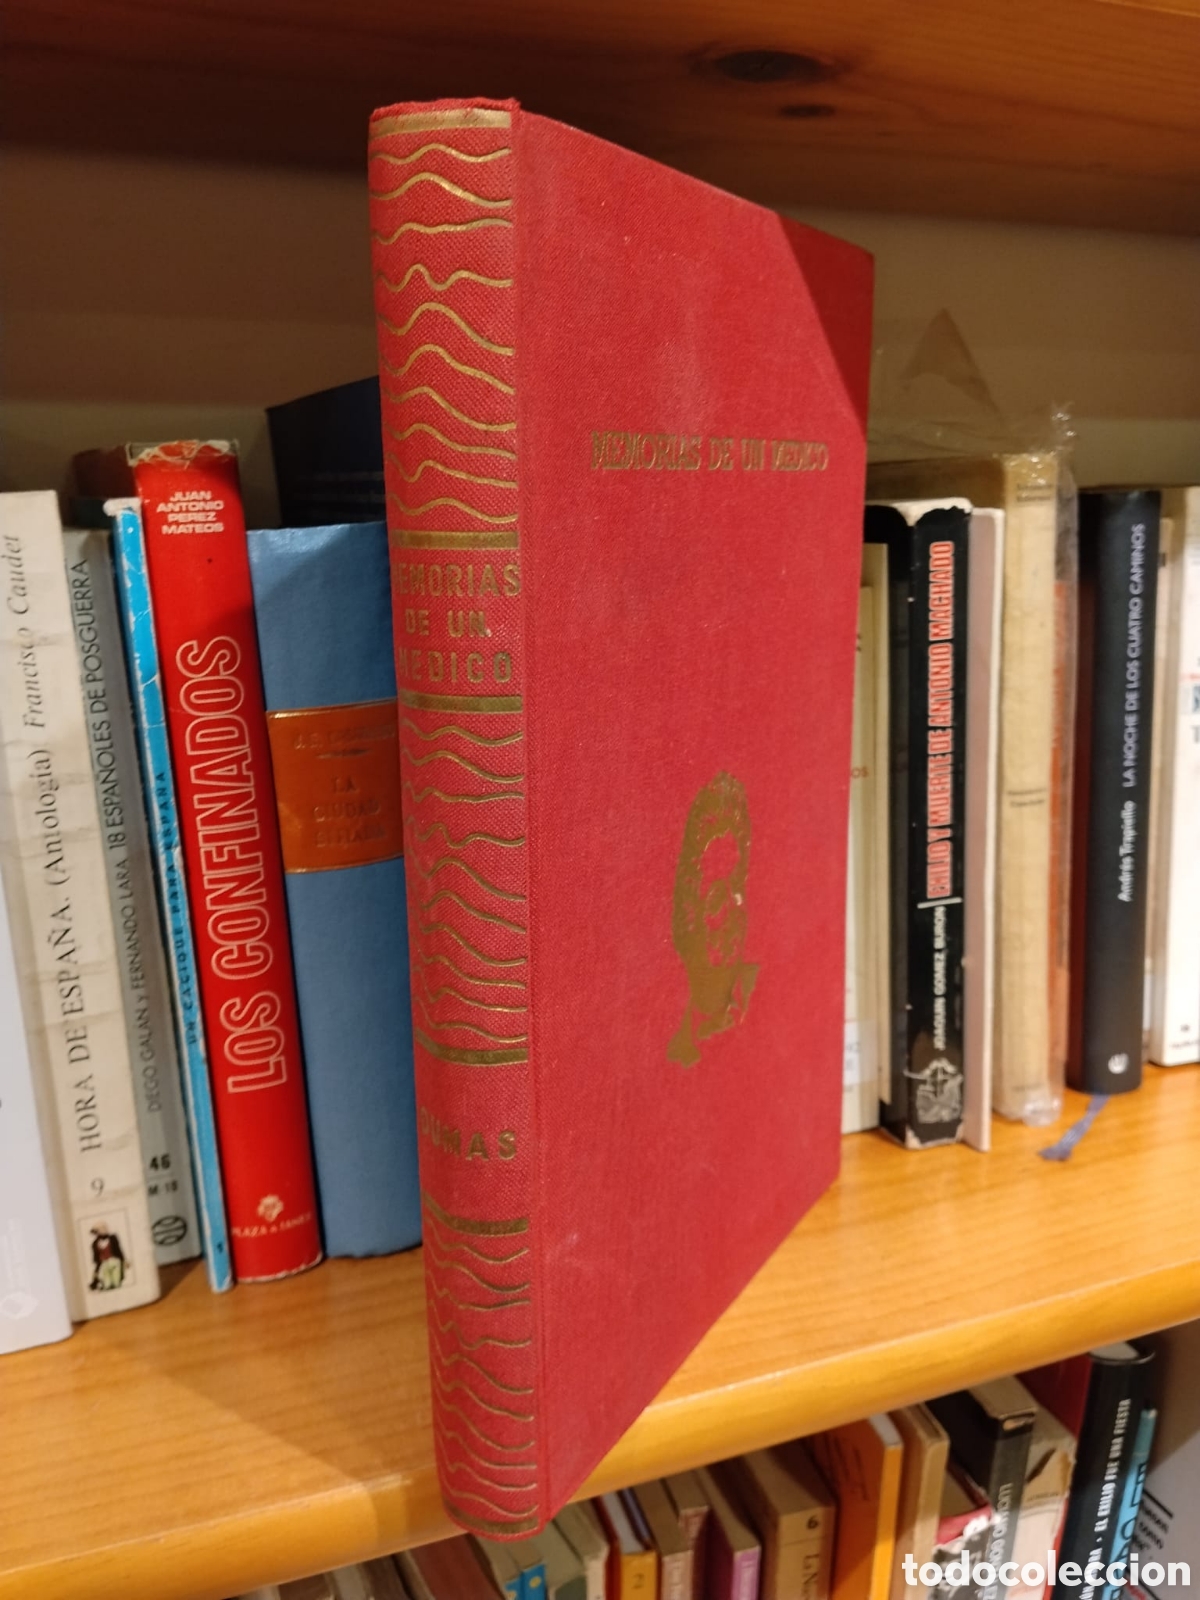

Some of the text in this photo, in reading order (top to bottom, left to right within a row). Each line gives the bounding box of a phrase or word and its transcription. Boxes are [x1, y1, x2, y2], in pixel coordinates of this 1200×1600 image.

[591, 430, 830, 472] MEMORIAS DE UN MEDICO
[156, 500, 224, 513] ANTONIO
[167, 511, 217, 523] PEREZ
[169, 490, 212, 502] JUAN
[161, 522, 225, 535] MATEOS
[1, 535, 29, 615] Caudet
[1129, 523, 1146, 595] CAMINOS
[70, 558, 103, 684] POSGUERRA
[405, 608, 486, 638] DE UN
[1126, 596, 1143, 659] CUATRO
[17, 627, 45, 728] Francisco
[1126, 659, 1141, 689] LOS
[87, 687, 109, 714] DE
[927, 540, 955, 899] EXILIO Y MUERTE DE ANTONIO MACHADO
[1125, 690, 1140, 711] DE
[1123, 712, 1140, 767] NOCHE
[92, 719, 125, 828] ESPAÑOLES
[1122, 768, 1138, 787] LA
[107, 831, 126, 850] 18
[175, 634, 288, 1094] LOS CONFINADOS
[115, 858, 134, 901] LARA
[166, 864, 181, 914] PARA
[47, 897, 84, 1016] ESPAÑA.
[120, 905, 145, 990] FERNANDO
[173, 926, 194, 1010] CACIQUE
[933, 905, 947, 1051] JOAQUIN GOMEZ BURON
[65, 1024, 91, 1064] DE
[184, 1020, 199, 1045] UN
[75, 1073, 102, 1152] HORA
[1093, 1398, 1131, 1533] EL EXILIO FUE UNA FIESTA
[806, 1515, 820, 1530] 6
